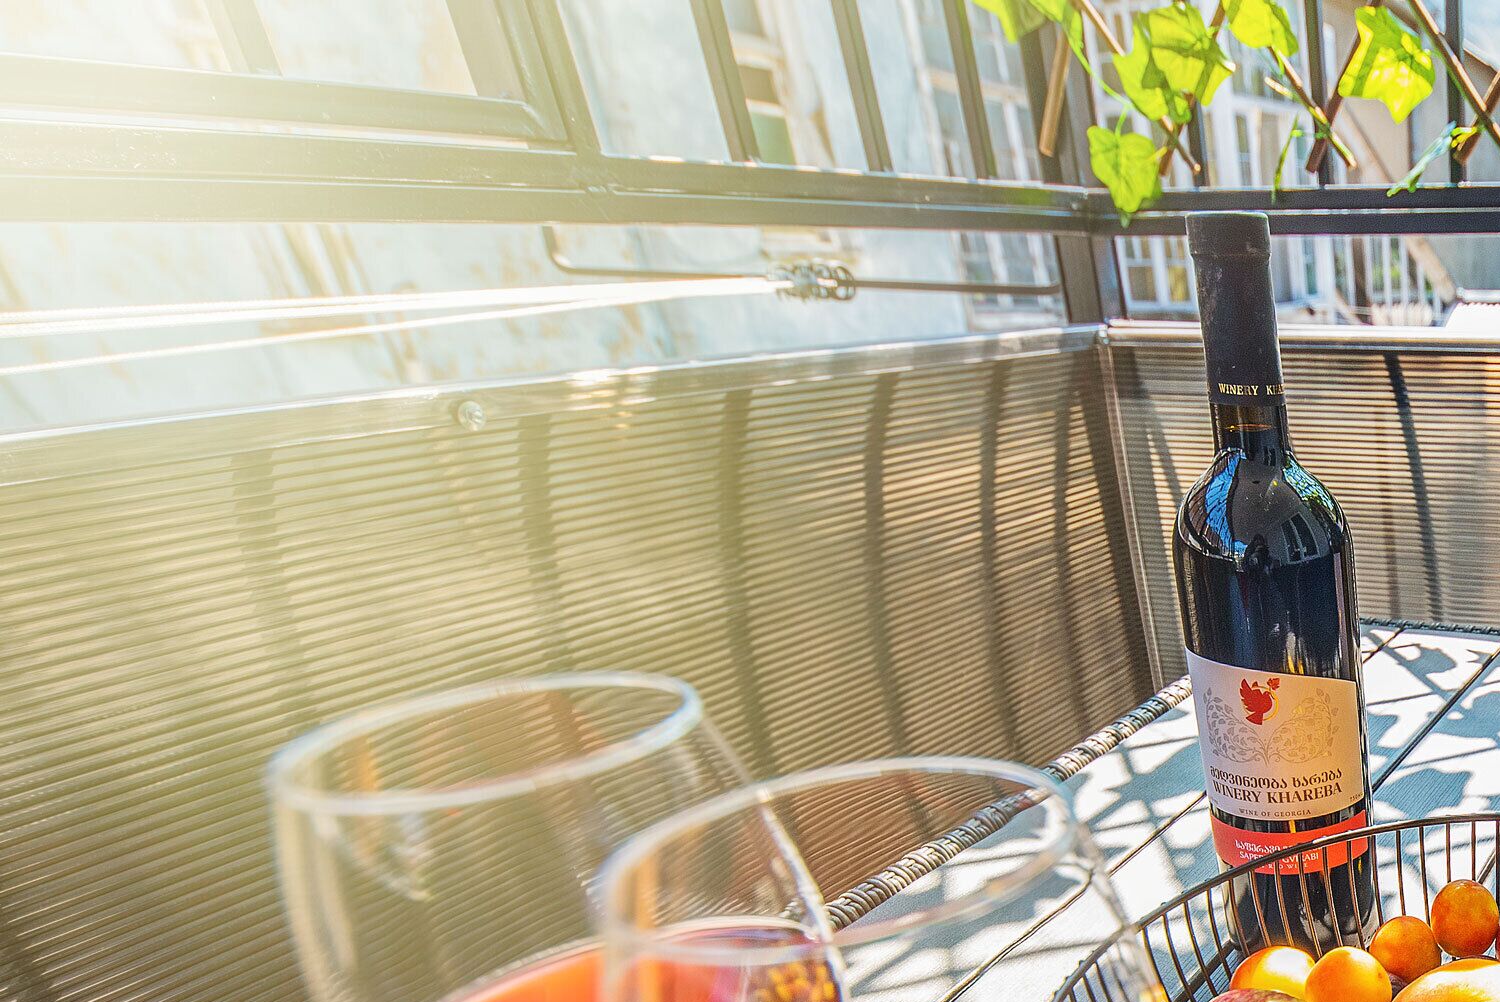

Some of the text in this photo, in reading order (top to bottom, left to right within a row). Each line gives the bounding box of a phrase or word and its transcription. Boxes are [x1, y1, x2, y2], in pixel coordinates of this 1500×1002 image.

[1218, 383, 1259, 396] WINERY
[1213, 780, 1343, 804] WINERY KHAREBA
[1239, 808, 1258, 816] WINE
[1274, 809, 1312, 817] GEORGIA
